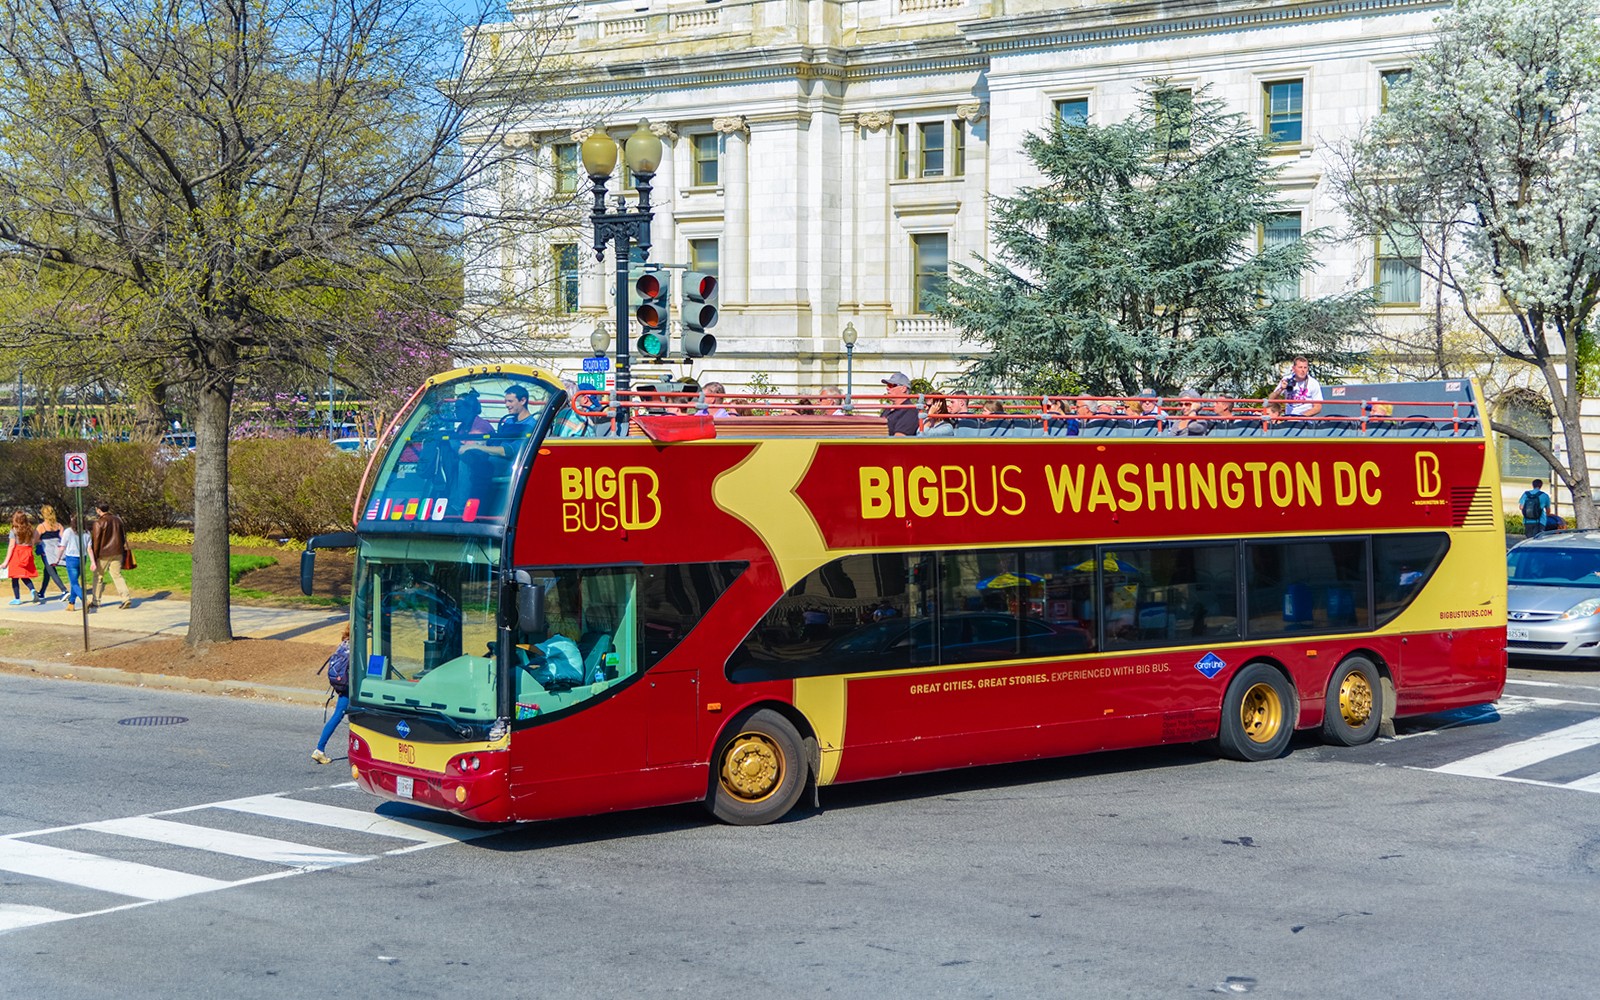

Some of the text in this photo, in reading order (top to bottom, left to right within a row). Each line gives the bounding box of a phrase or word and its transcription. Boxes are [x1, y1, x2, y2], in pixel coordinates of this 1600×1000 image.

[561, 466, 617, 500] BIG
[1045, 461, 1322, 514] WASHINGTON
[1333, 461, 1382, 506] DC
[563, 501, 618, 532] BUS
[1440, 609, 1493, 619] BIGBUSTOURS.COM
[910, 662, 1171, 695] GREAT CITIES. GREAT STORIES. EXPERIENCED WITH BIG BUS.
